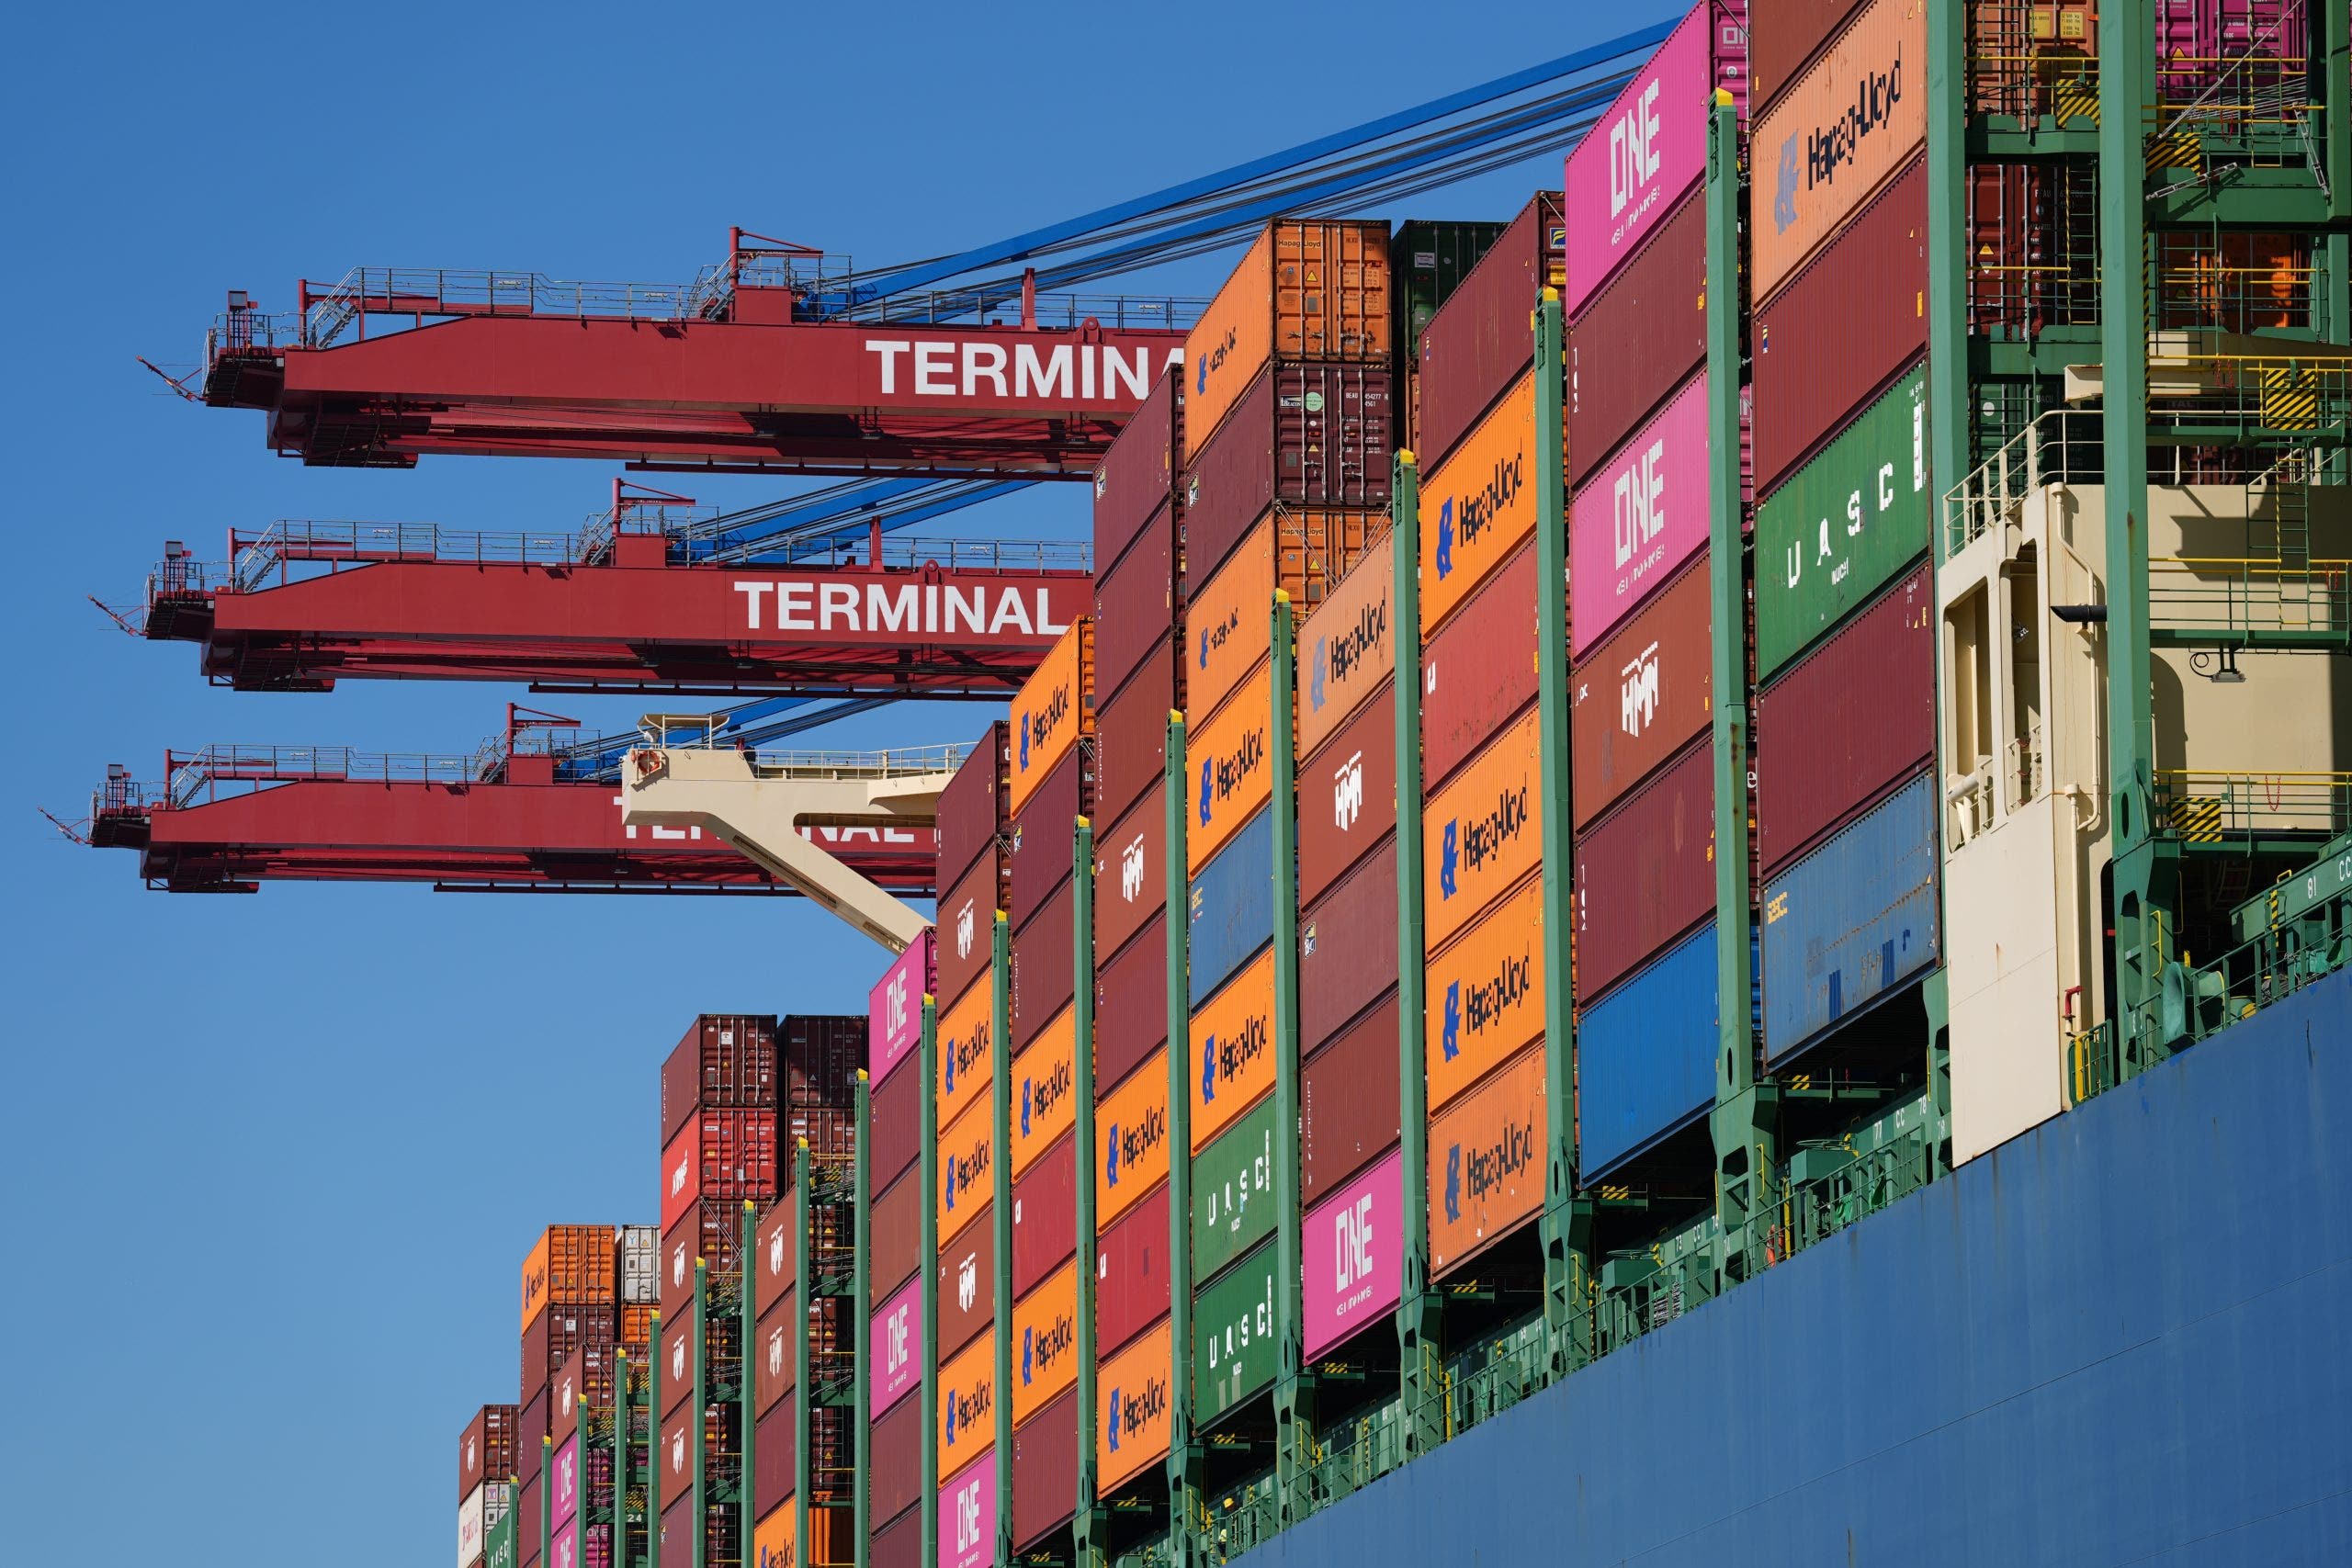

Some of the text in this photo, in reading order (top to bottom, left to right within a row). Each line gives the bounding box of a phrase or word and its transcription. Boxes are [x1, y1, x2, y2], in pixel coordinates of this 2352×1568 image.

[1611, 77, 1660, 220] ONE
[1807, 40, 1901, 191] Hapag-Lloyd
[1459, 436, 1522, 547] Hapag-Lloyd
[1615, 439, 1664, 570] ONE
[1788, 462, 1894, 589] UASC
[733, 581, 1070, 635] TERMINAL
[1331, 586, 1385, 683] Hapag-Lloyd
[1464, 772, 1527, 872] Hapag-Lloyd
[2308, 875, 2317, 899] 81
[887, 966, 907, 1043] ONE
[1466, 941, 1530, 1036] Hapag-Lloyd
[1336, 1193, 1373, 1294] ONE
[888, 1303, 908, 1375] ONE
[1210, 1302, 1265, 1369] UASC
[957, 1479, 980, 1555] ONE
